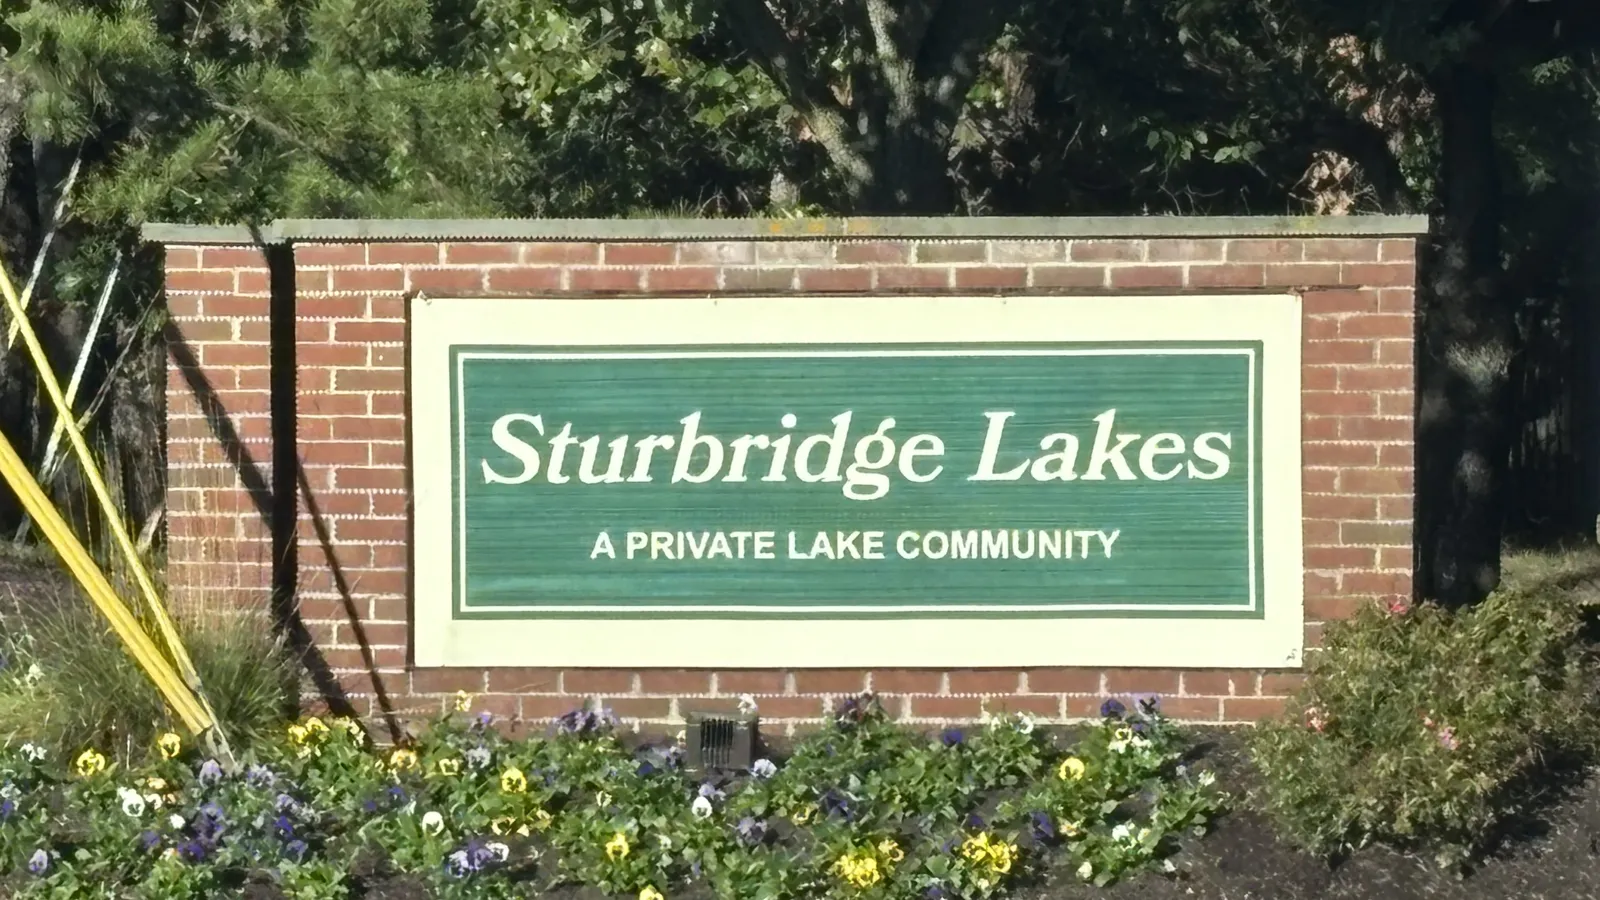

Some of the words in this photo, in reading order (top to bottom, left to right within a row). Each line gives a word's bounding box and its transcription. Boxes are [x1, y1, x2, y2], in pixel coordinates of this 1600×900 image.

[481, 410, 945, 501] Sturbridge
[966, 408, 1233, 483] Lakes
[590, 531, 616, 560] A
[626, 530, 776, 560] PRIVATE
[788, 530, 886, 560] LAKE
[896, 529, 1121, 561] COMMUNITY
